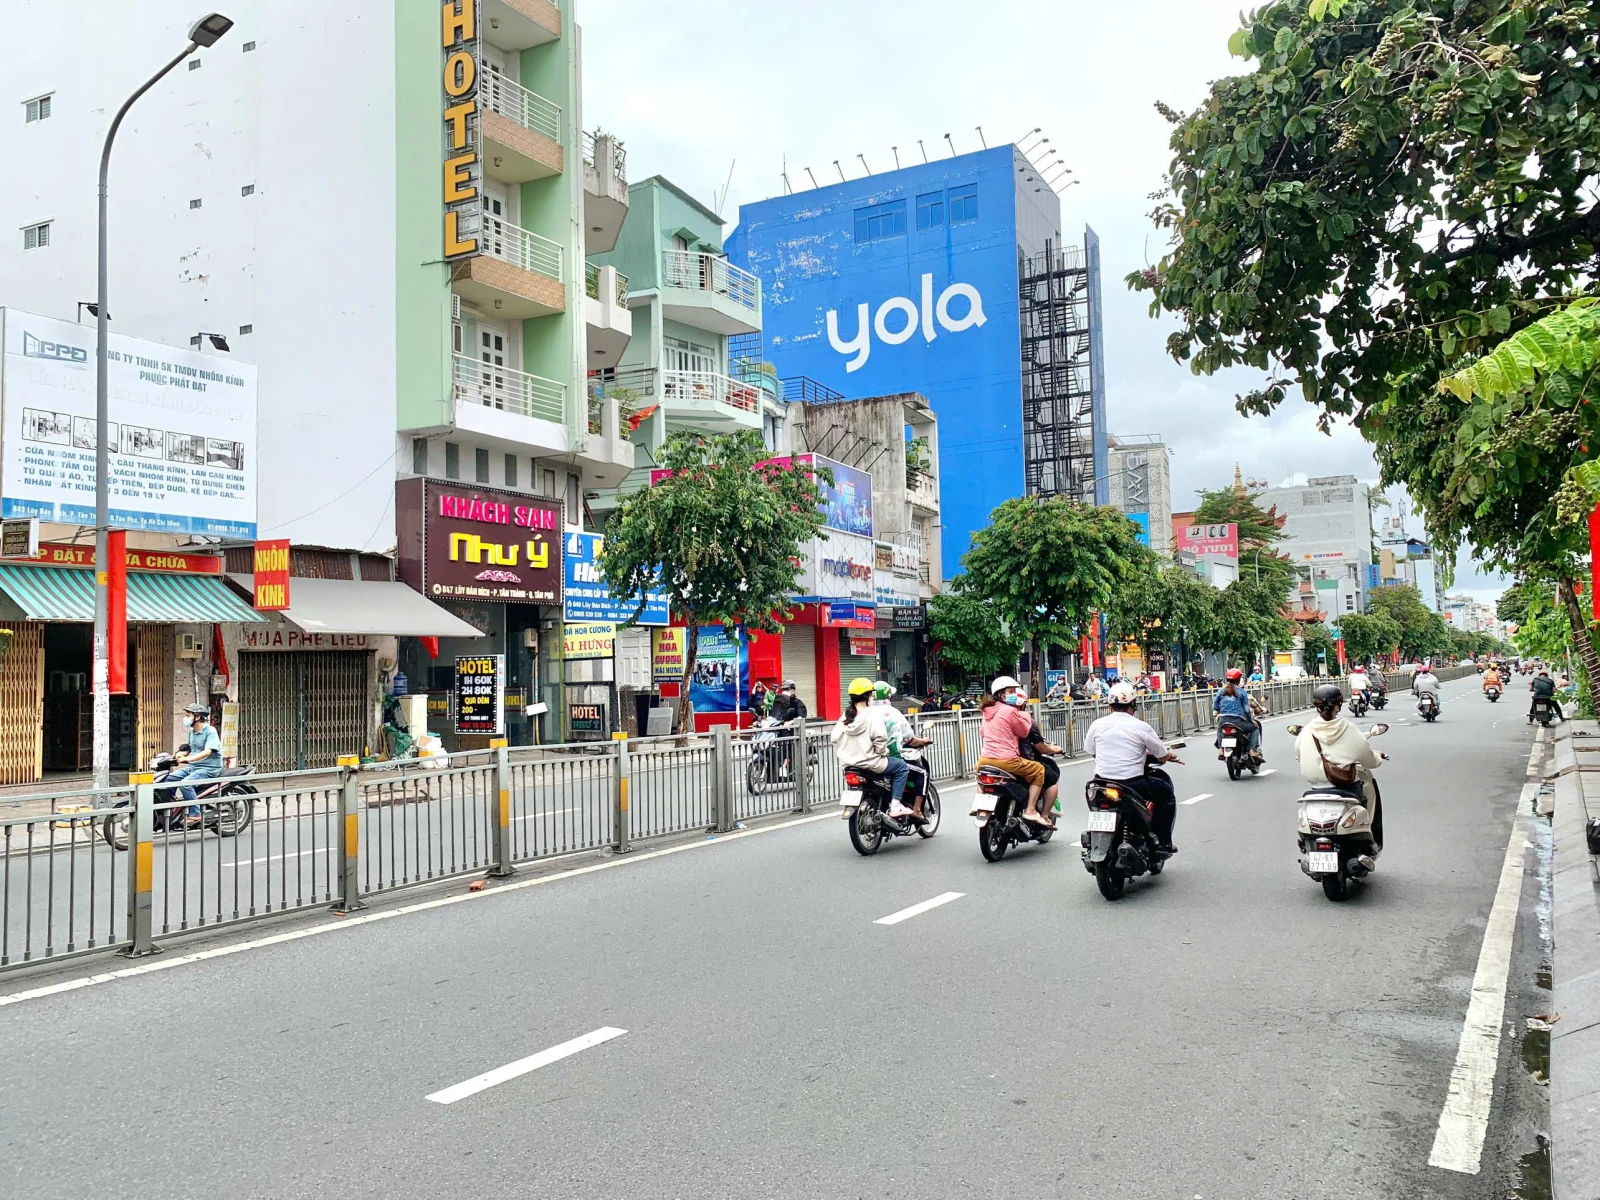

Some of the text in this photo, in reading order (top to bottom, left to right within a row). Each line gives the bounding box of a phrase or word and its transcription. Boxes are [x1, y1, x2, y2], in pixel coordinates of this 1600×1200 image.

[444, 0, 476, 256] HOTEL
[826, 273, 988, 373] yola
[123, 354, 133, 363] TY
[136, 356, 158, 369] TNHH
[161, 362, 172, 372] SX
[174, 364, 197, 377] TMDV
[200, 368, 223, 382] NHÔM
[226, 374, 244, 387] KÍNH
[170, 377, 190, 389] PHÁT
[192, 381, 207, 392] ĐẠT
[48, 449, 76, 459] NÔM
[137, 462, 165, 471] THANG
[226, 474, 244, 482] KÍNH
[440, 495, 556, 532] KHÁCH SẠN
[54, 549, 84, 564] ĐẶT
[146, 555, 187, 569] CHỮA
[255, 545, 288, 572] NHÔM
[258, 581, 285, 607] KÍNH
[658, 642, 677, 652] HOA
[460, 660, 494, 674] HOTEL
[461, 686, 492, 695] 2H 80K
[474, 676, 492, 685] 60K
[572, 706, 600, 719] HOTEL
